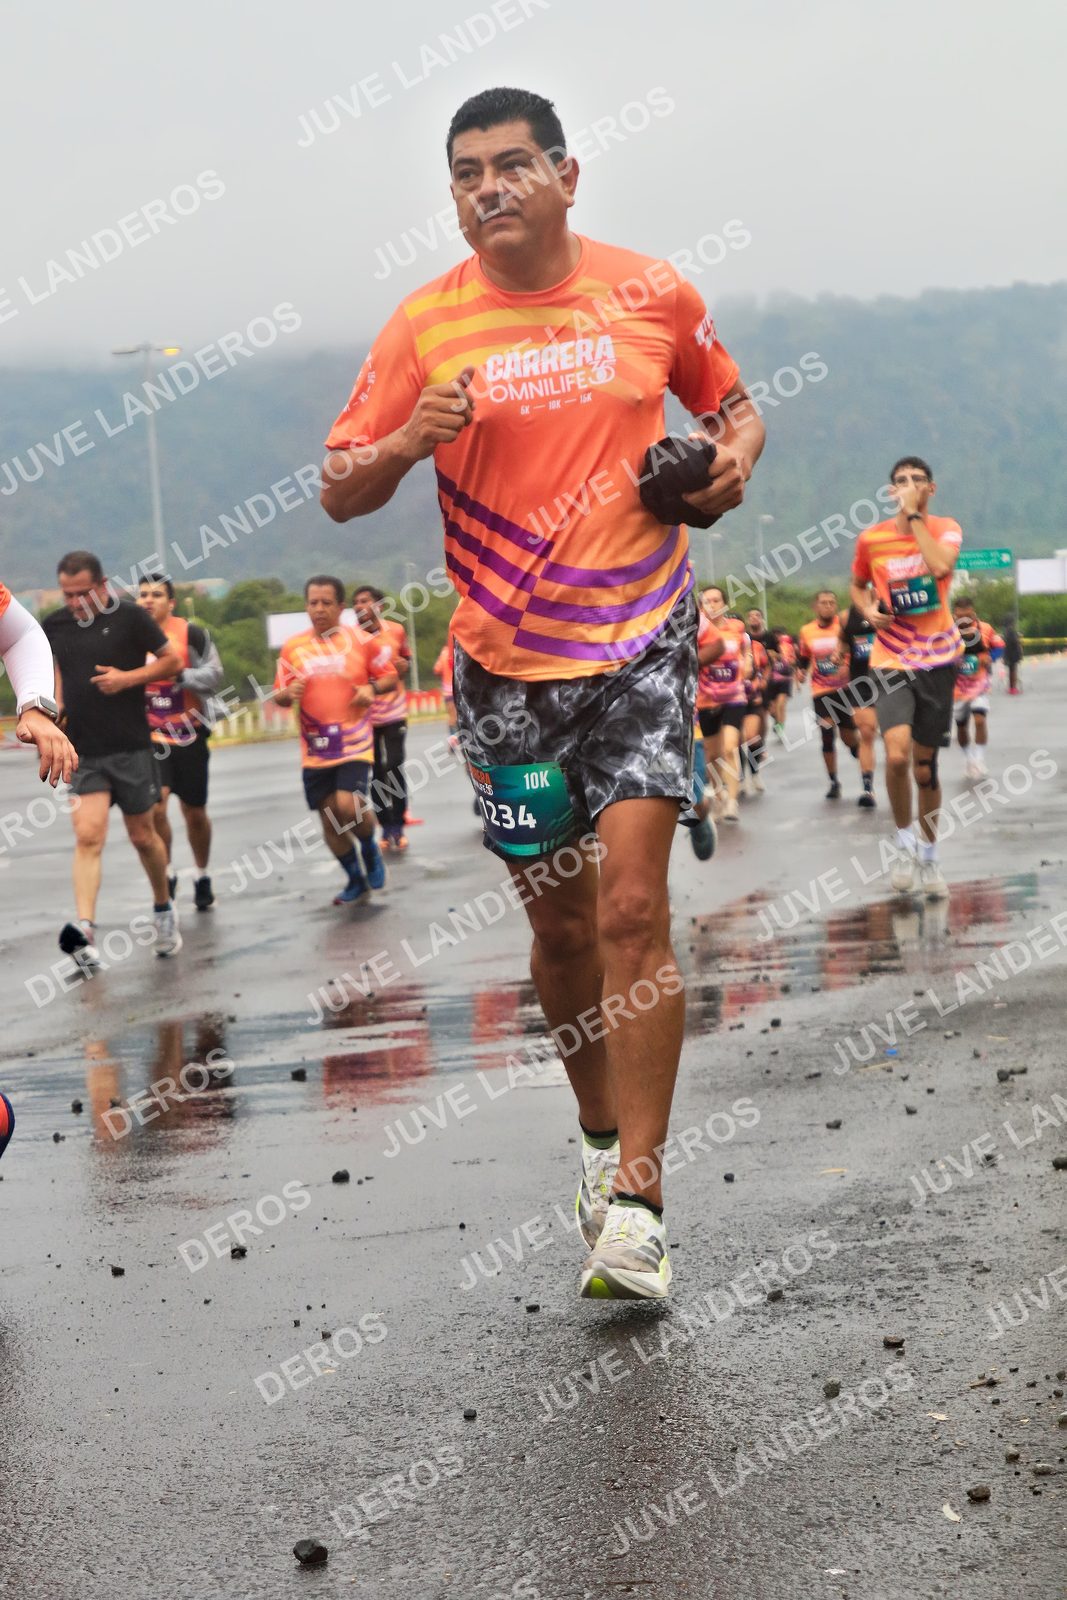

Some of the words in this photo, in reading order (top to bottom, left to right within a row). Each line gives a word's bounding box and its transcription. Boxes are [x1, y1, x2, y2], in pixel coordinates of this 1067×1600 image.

[486, 335, 616, 382] CARRERA
[489, 370, 588, 403] OMNILIFE
[524, 770, 550, 790] 10K
[479, 796, 537, 829] 1234
